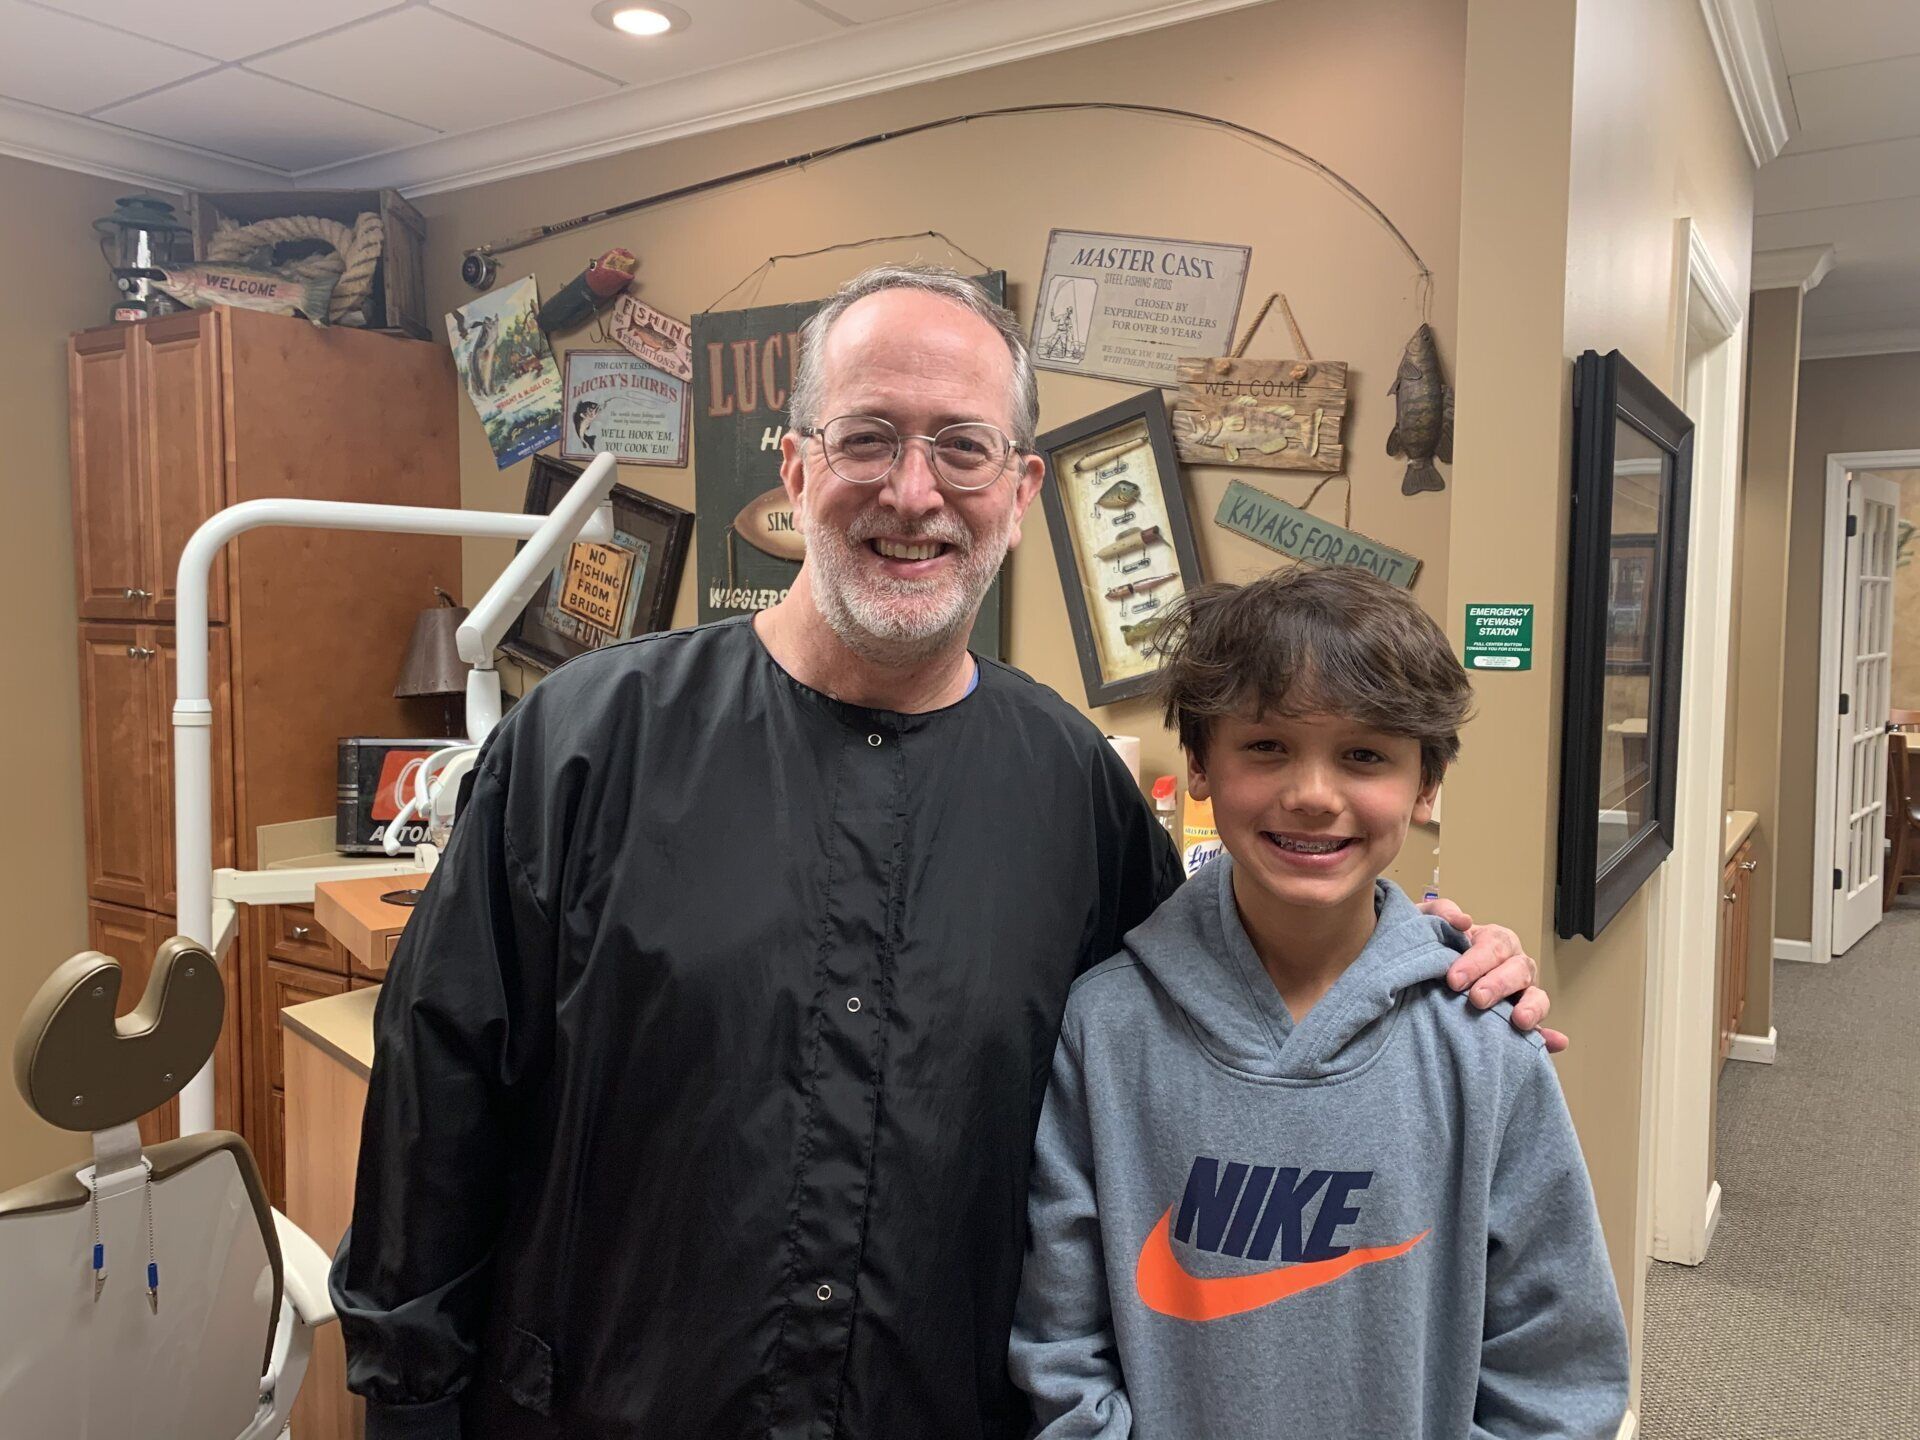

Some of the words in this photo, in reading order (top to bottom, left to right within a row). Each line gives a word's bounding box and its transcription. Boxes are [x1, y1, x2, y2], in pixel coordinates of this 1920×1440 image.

[1070, 247, 1155, 274] MASTER
[1161, 252, 1216, 280] CAST
[206, 274, 277, 297] WELCOME
[1104, 272, 1124, 286] STEEL
[1124, 275, 1151, 289] FISHING
[1135, 298, 1173, 311] CHOSEN
[1175, 302, 1189, 312] BY
[1103, 306, 1169, 323] EXPERIENCED
[1170, 314, 1217, 329] ANGLERS
[1112, 319, 1131, 331] FOR
[1132, 322, 1158, 335] OVER
[1159, 325, 1169, 336] 50
[1171, 326, 1203, 340] YEARS
[622, 334, 677, 370] EXPEDITIONS
[593, 361, 609, 369] FISH
[572, 372, 629, 398] LUCKY'S
[631, 374, 678, 403] LURES
[1203, 379, 1308, 399] WELCOME
[601, 428, 626, 439] WE'LL
[628, 429, 653, 441] HOOK
[604, 441, 622, 453] YOU
[624, 442, 648, 454] COOK
[1227, 495, 1304, 550] KAYAKS
[1301, 527, 1343, 565] FOR
[589, 548, 607, 566] NO
[573, 560, 620, 590] FISHING
[577, 578, 610, 603] FROM
[569, 592, 612, 622] BRIDGE
[1470, 607, 1530, 616] EMERGENCY
[1476, 618, 1522, 626] EYEWASH
[1479, 628, 1518, 636] STATION
[575, 621, 604, 648] FUN
[1188, 843, 1223, 868] Lysol
[1174, 1155, 1374, 1264] NIKE
